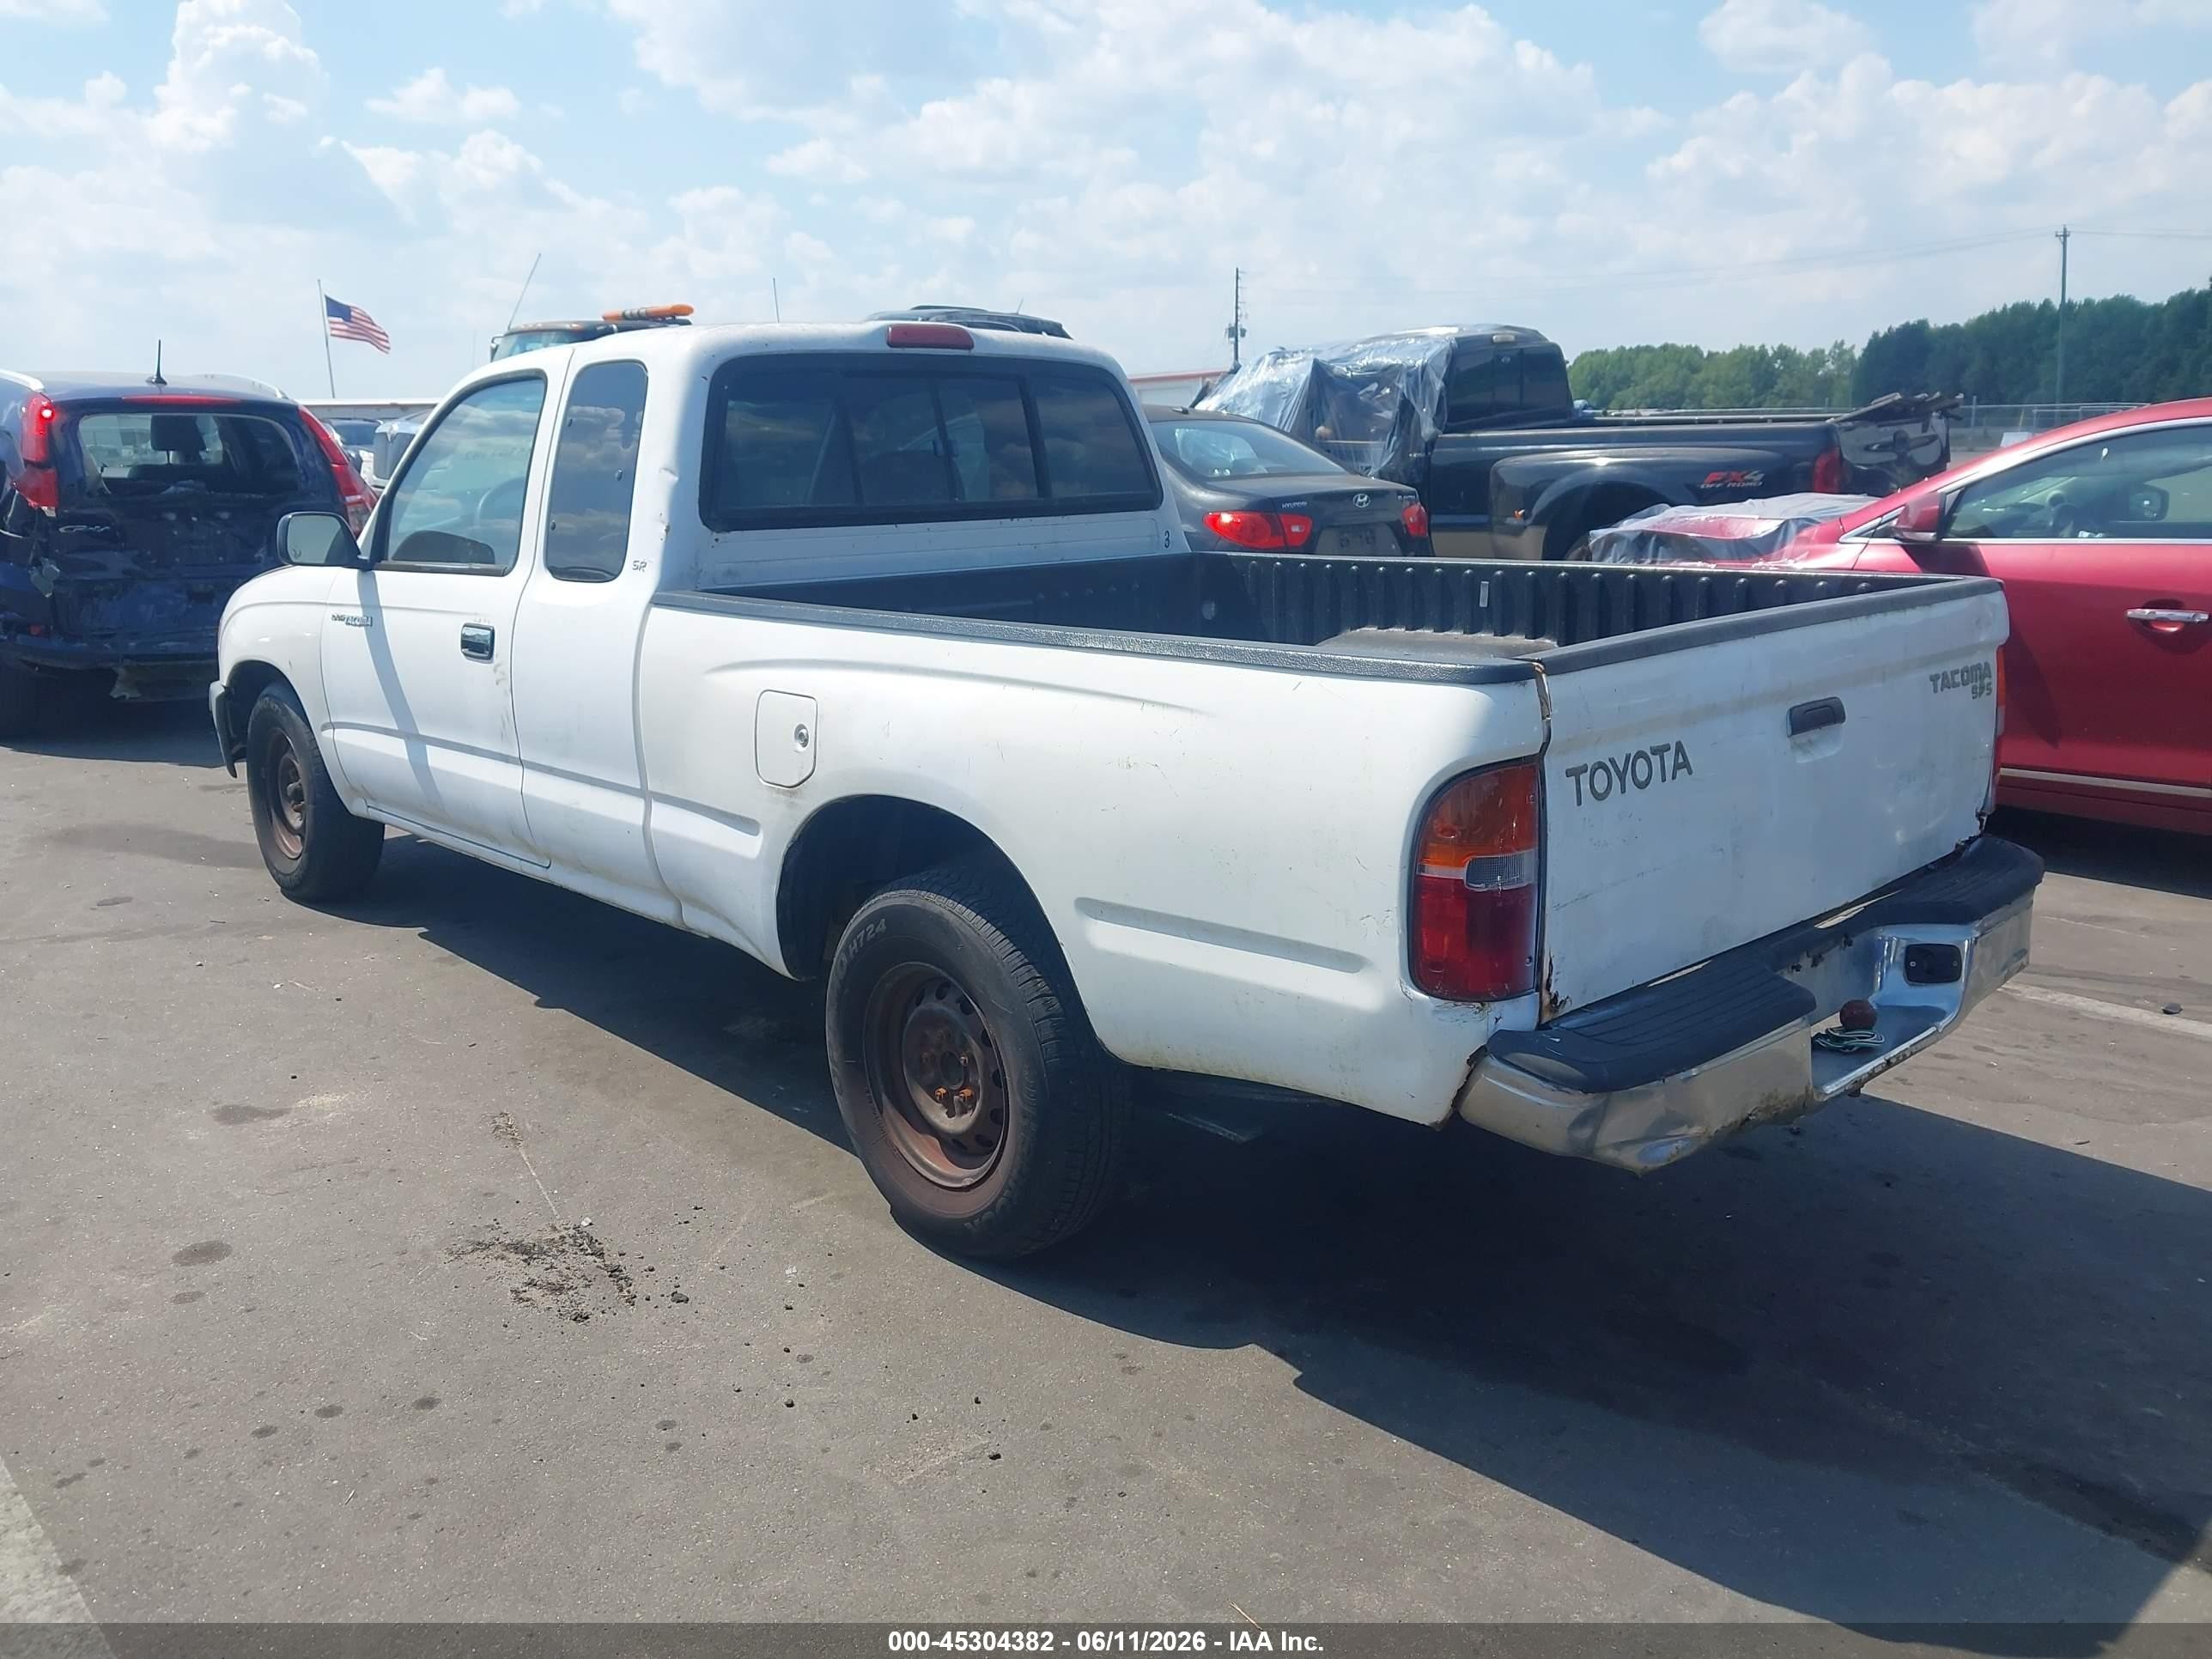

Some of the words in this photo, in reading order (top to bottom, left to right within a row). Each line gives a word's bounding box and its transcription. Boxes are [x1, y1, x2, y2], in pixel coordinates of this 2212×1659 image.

[1704, 469, 1765, 483] FX4
[1164, 530, 1170, 549] 3
[1929, 661, 1992, 694] TACOMA
[1565, 740, 1693, 807] TOYOTA
